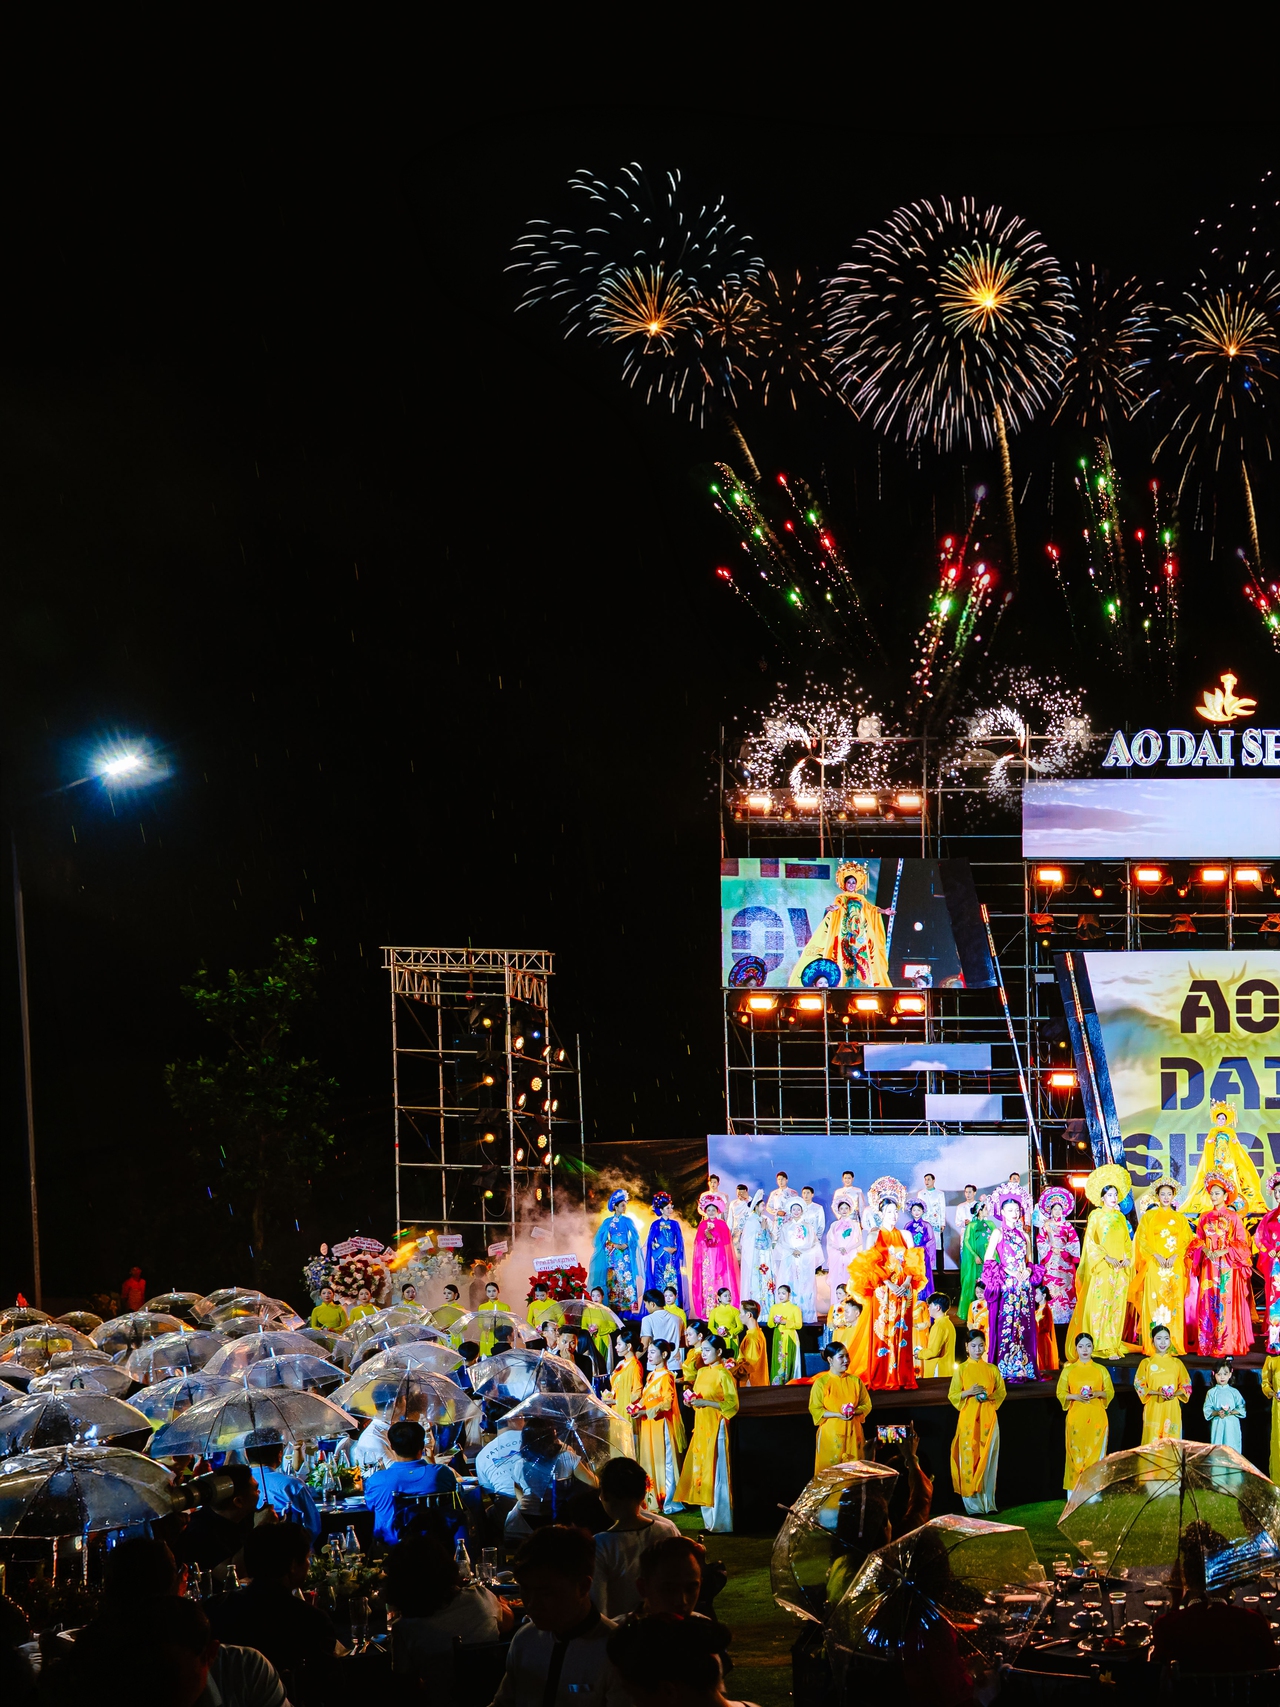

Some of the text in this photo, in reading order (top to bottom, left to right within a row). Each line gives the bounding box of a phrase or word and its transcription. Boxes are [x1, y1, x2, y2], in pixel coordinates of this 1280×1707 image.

[1102, 730, 1163, 767] AO
[1166, 730, 1235, 767] DAI
[1180, 979, 1280, 1033] AO
